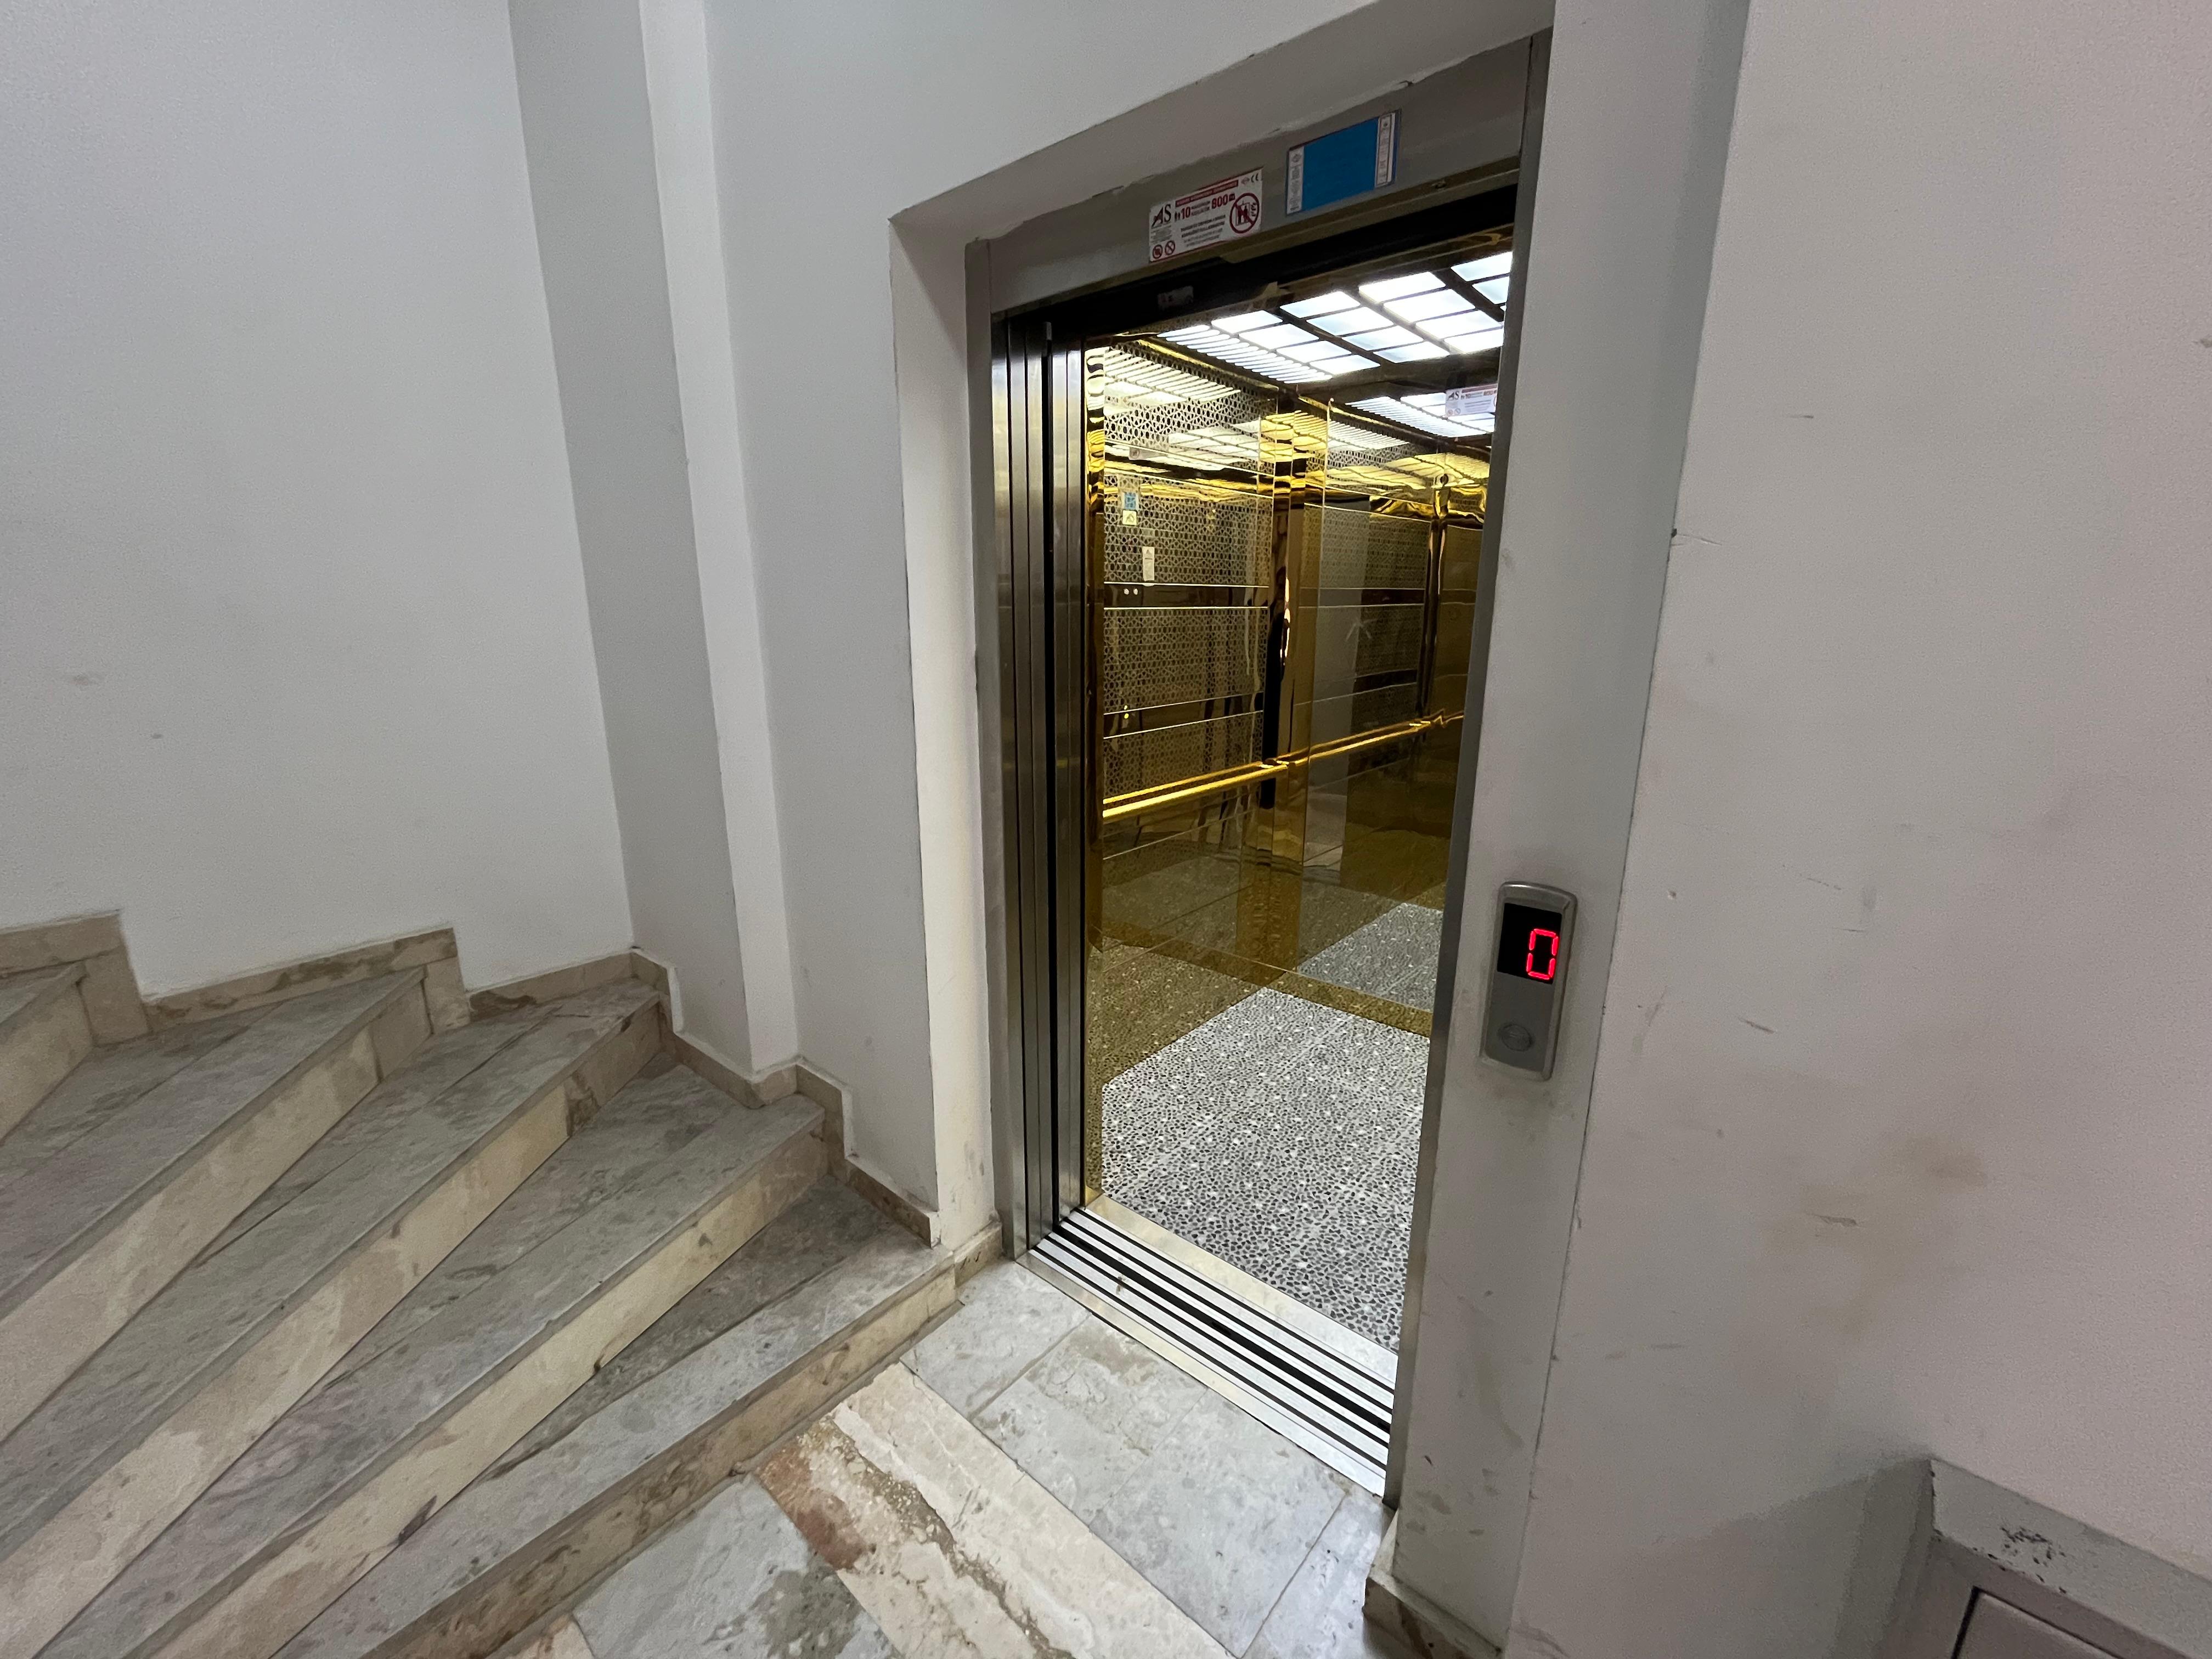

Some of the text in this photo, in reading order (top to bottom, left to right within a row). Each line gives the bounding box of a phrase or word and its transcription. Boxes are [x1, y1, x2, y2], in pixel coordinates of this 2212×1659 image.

[1211, 194, 1228, 209] 800
[1152, 204, 1171, 227] AS
[1526, 928, 1559, 980] 0
